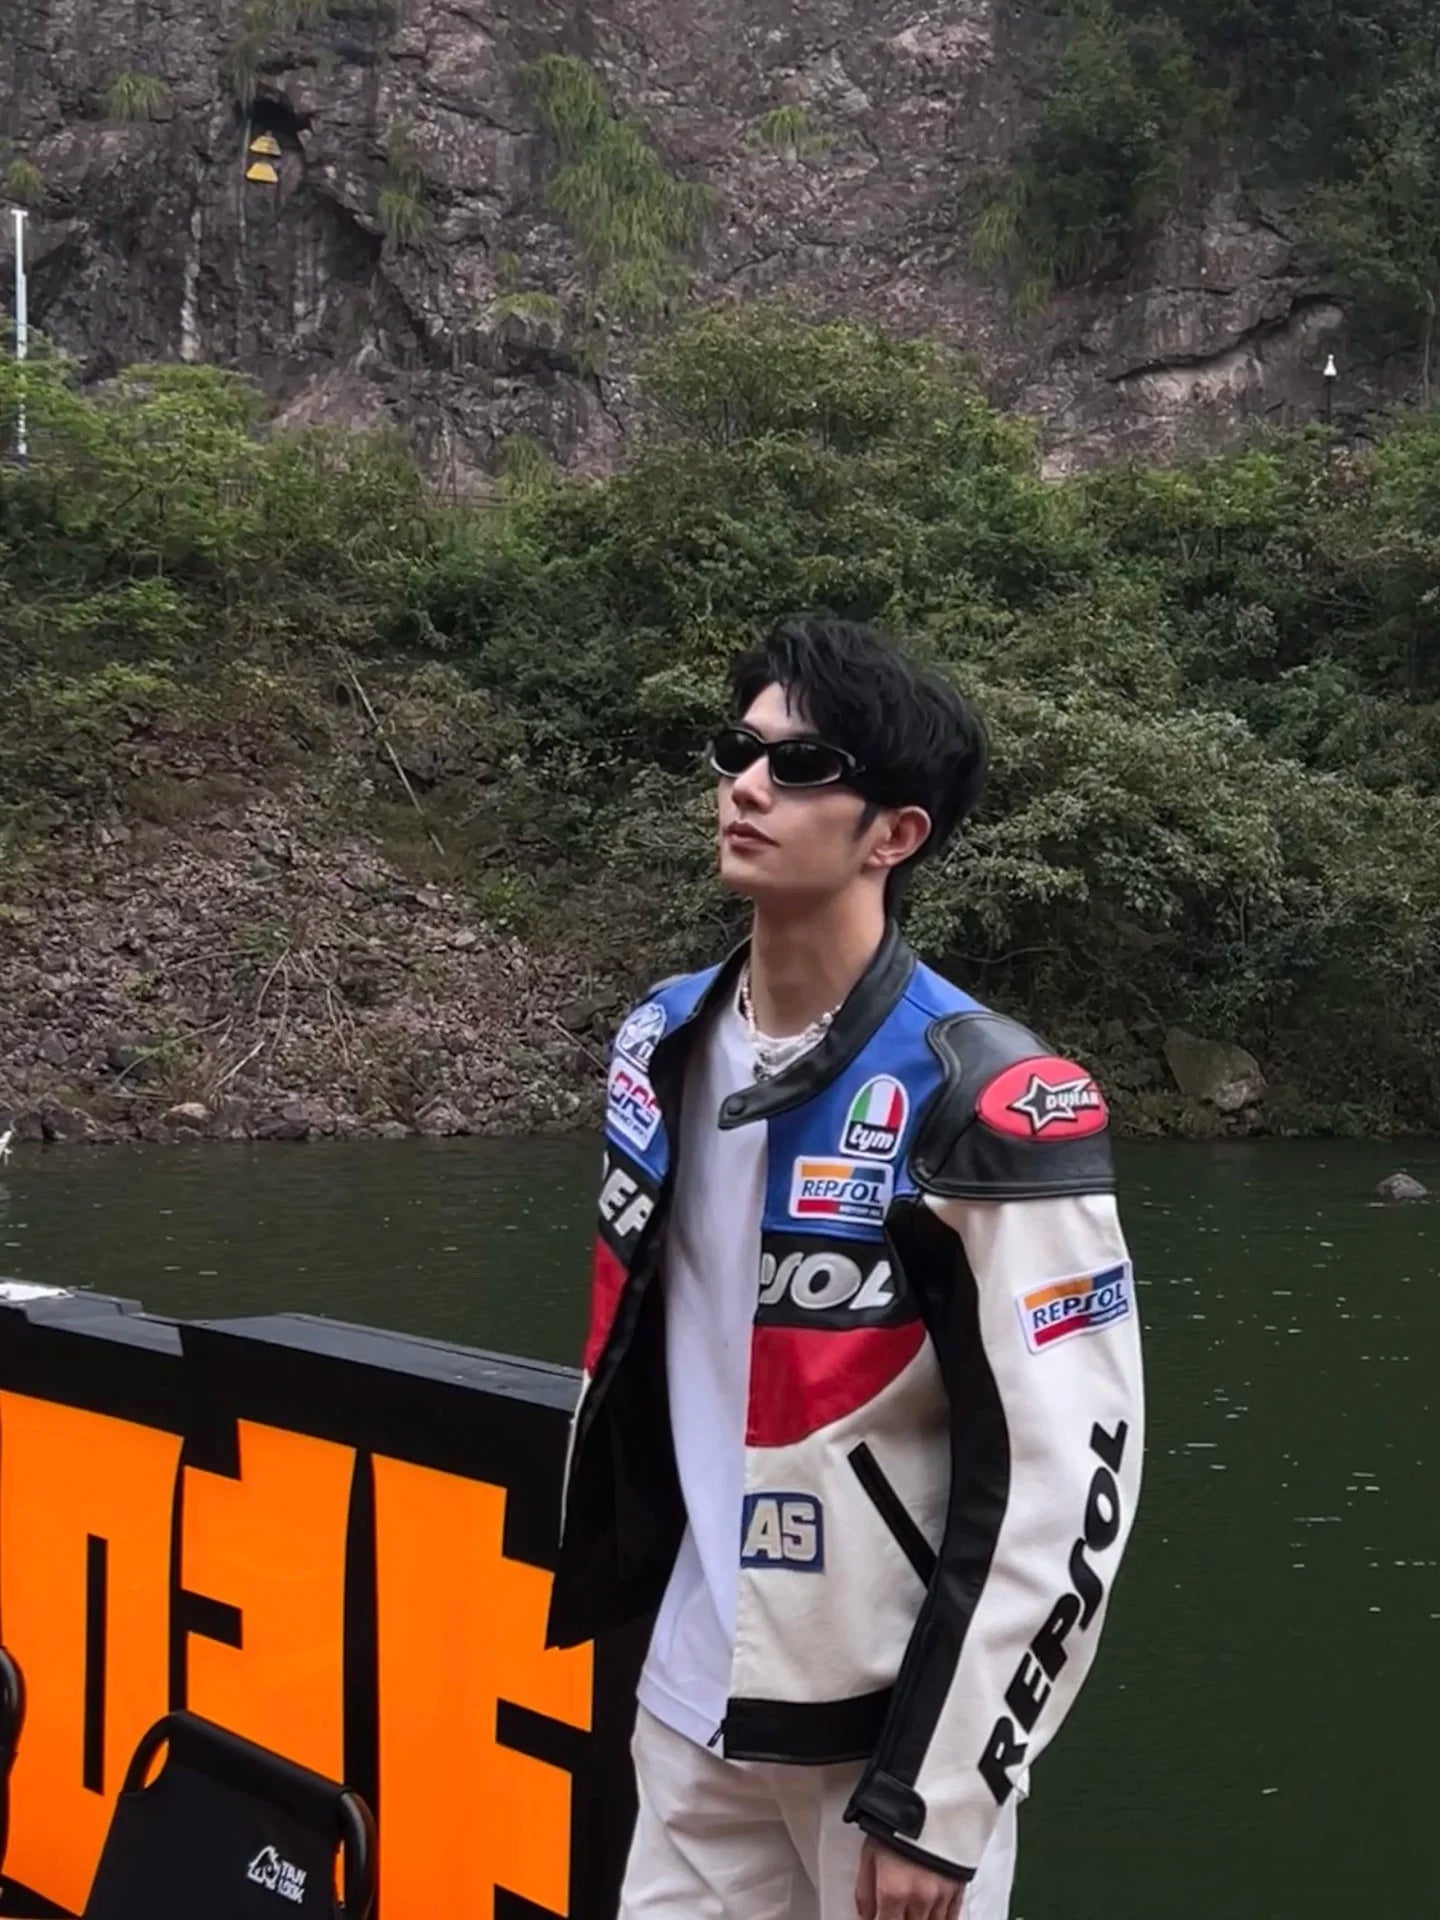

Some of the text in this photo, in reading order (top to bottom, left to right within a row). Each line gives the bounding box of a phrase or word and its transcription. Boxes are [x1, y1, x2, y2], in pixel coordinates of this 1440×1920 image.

[849, 1124, 895, 1151] tym
[801, 1179, 881, 1204] REPSOL
[1033, 1283, 1123, 1329] REPSOL
[977, 1420, 1129, 1807] REPSOL
